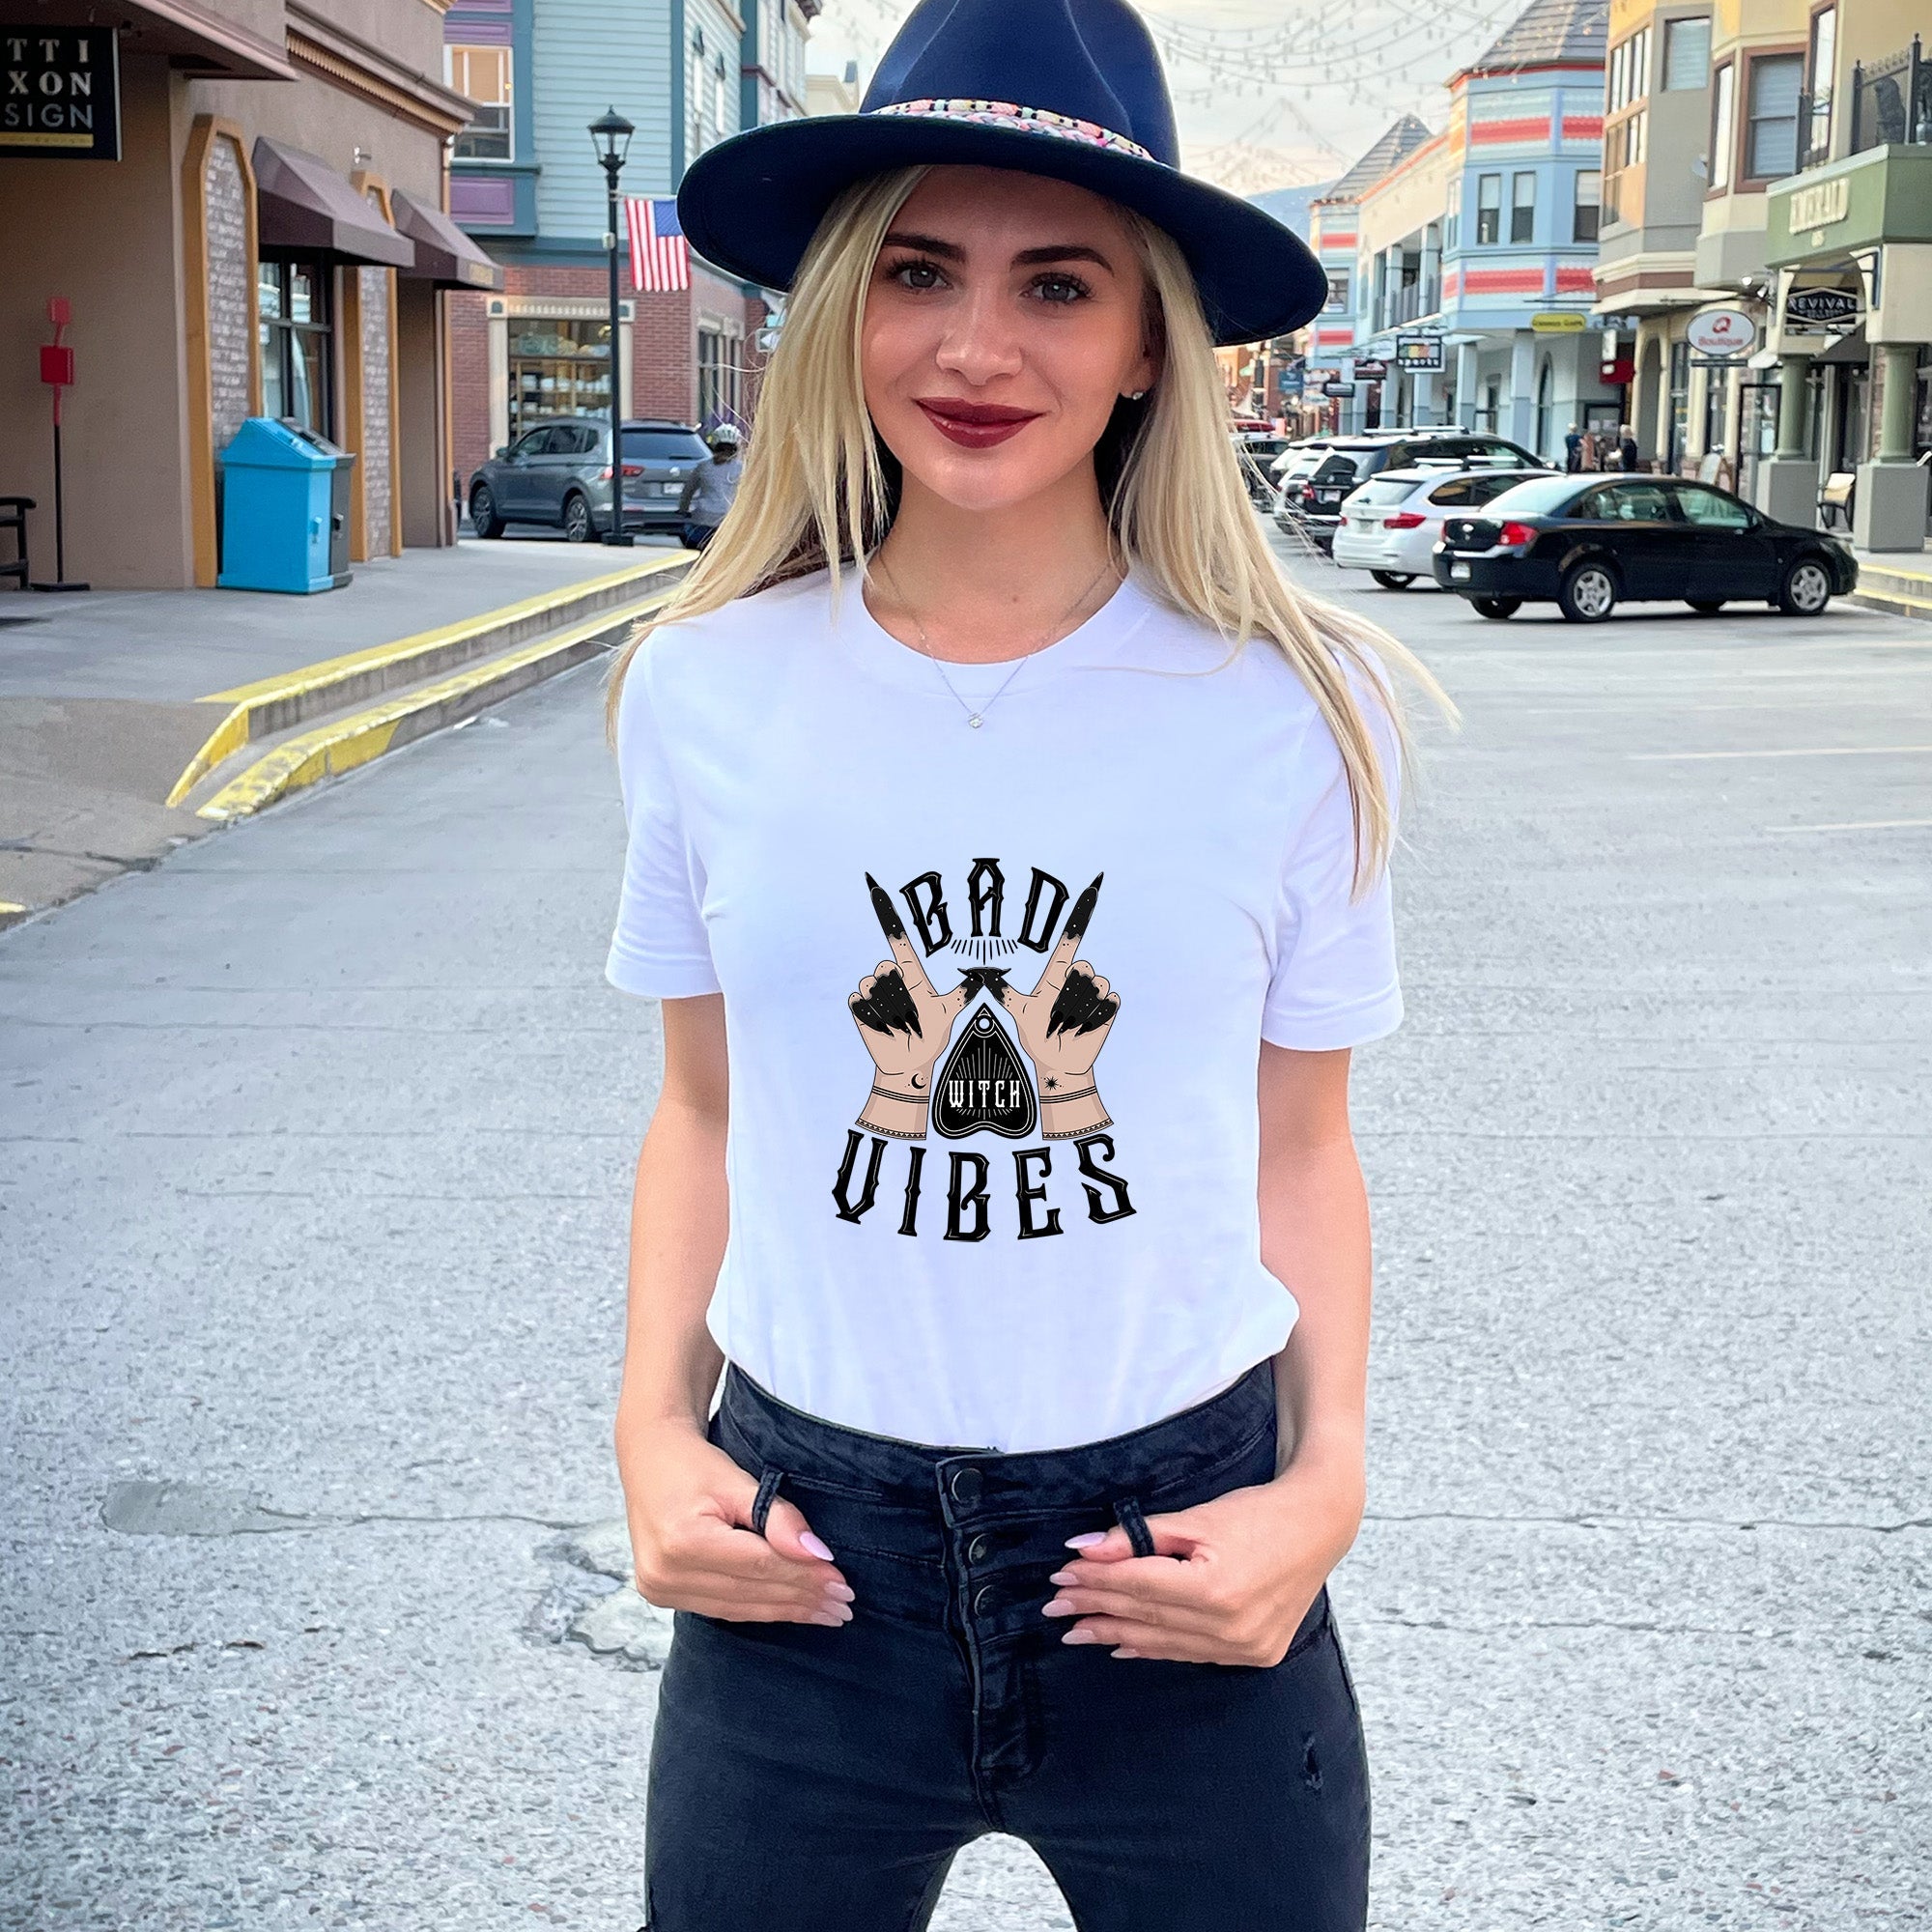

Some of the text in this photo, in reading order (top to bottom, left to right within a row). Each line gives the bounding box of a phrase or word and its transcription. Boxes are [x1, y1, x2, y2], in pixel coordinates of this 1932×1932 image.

[8, 71, 93, 97] XON
[4, 102, 94, 129] SIGN
[1787, 297, 1856, 311] REVIVAL
[899, 858, 1069, 958] BAD
[949, 1079, 1021, 1109] WITCH
[832, 1128, 1138, 1242] VIBES
